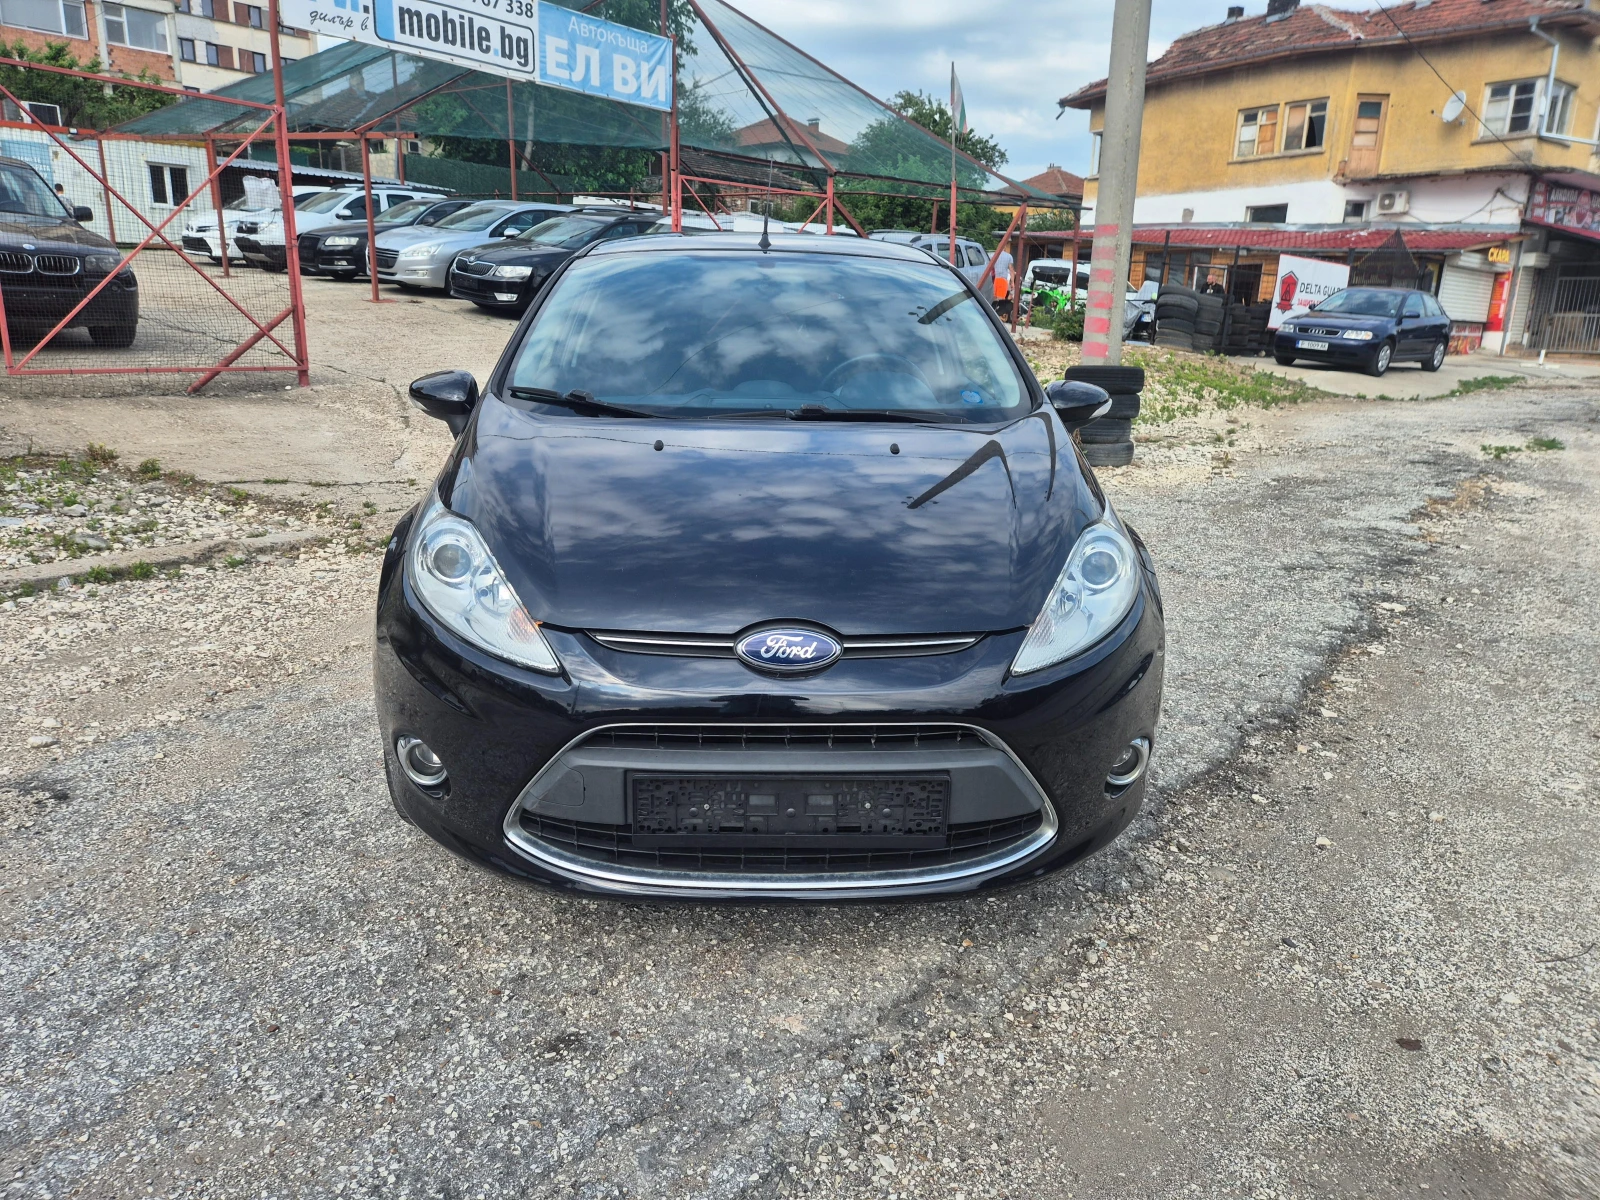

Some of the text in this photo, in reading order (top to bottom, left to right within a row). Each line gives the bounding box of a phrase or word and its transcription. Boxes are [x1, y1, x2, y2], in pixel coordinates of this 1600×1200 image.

[309, 10, 354, 31] дилър
[506, 0, 533, 19] 338
[398, 5, 529, 68] mobile.bg
[568, 16, 648, 55] Автокъща
[545, 34, 666, 102] ЕЛ ВИ
[1299, 282, 1321, 296] DELTA
[760, 635, 818, 659] Ford
